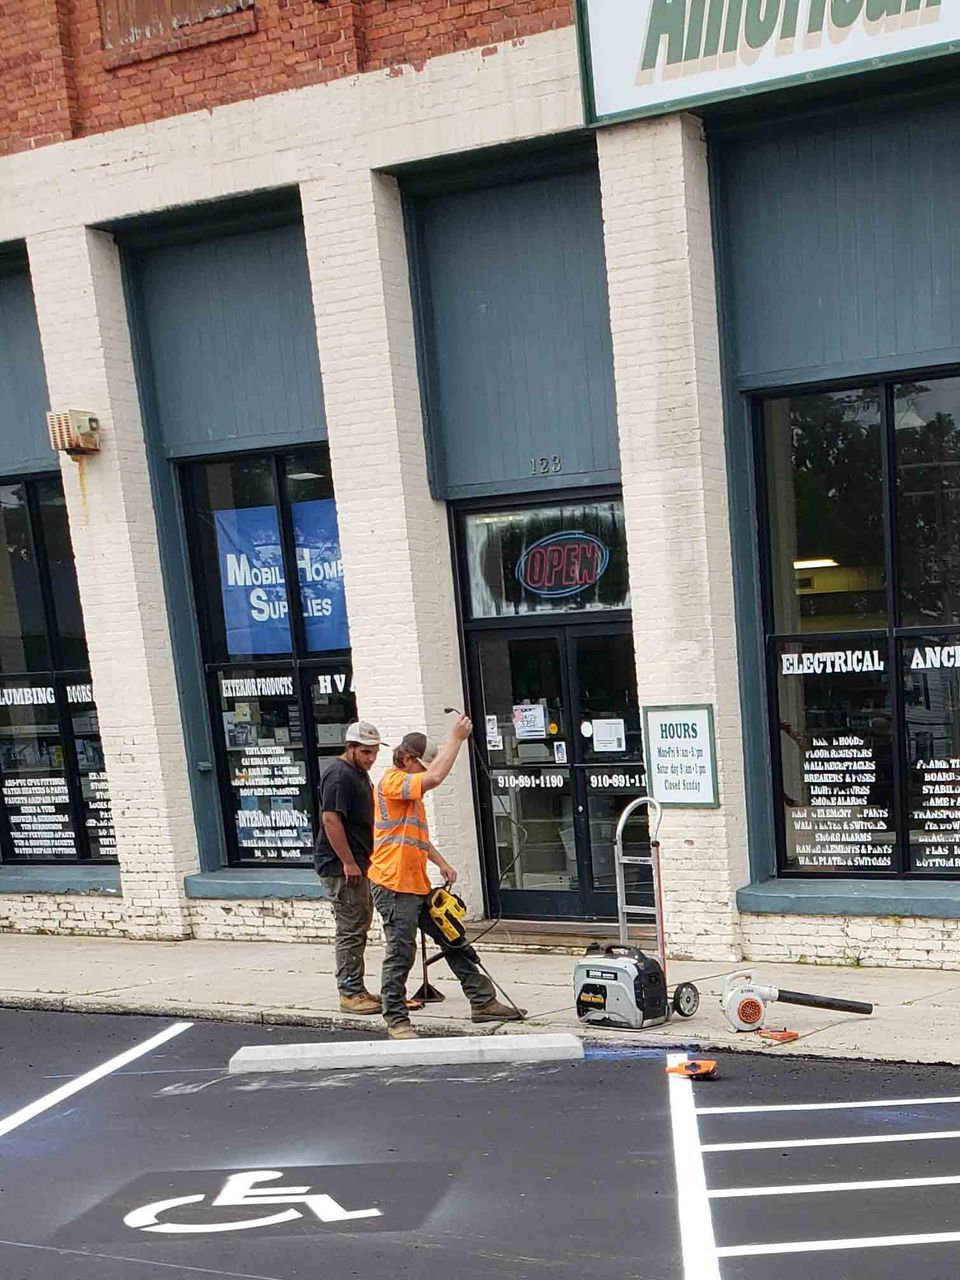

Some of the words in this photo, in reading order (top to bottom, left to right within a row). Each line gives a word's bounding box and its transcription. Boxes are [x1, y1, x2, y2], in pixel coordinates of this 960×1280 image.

[530, 456, 562, 475] 123
[226, 553, 285, 586] MOBIL
[527, 543, 598, 587] OPEN
[250, 587, 332, 621] SUPIES
[781, 650, 884, 674] ELECTRICAL
[222, 678, 257, 697] EXTERIOR
[257, 677, 293, 696] PRODUCTS
[318, 674, 356, 694] HV
[0, 687, 55, 705] LUMBING
[660, 722, 698, 740] HOURS
[804, 773, 844, 782] BREAKERS
